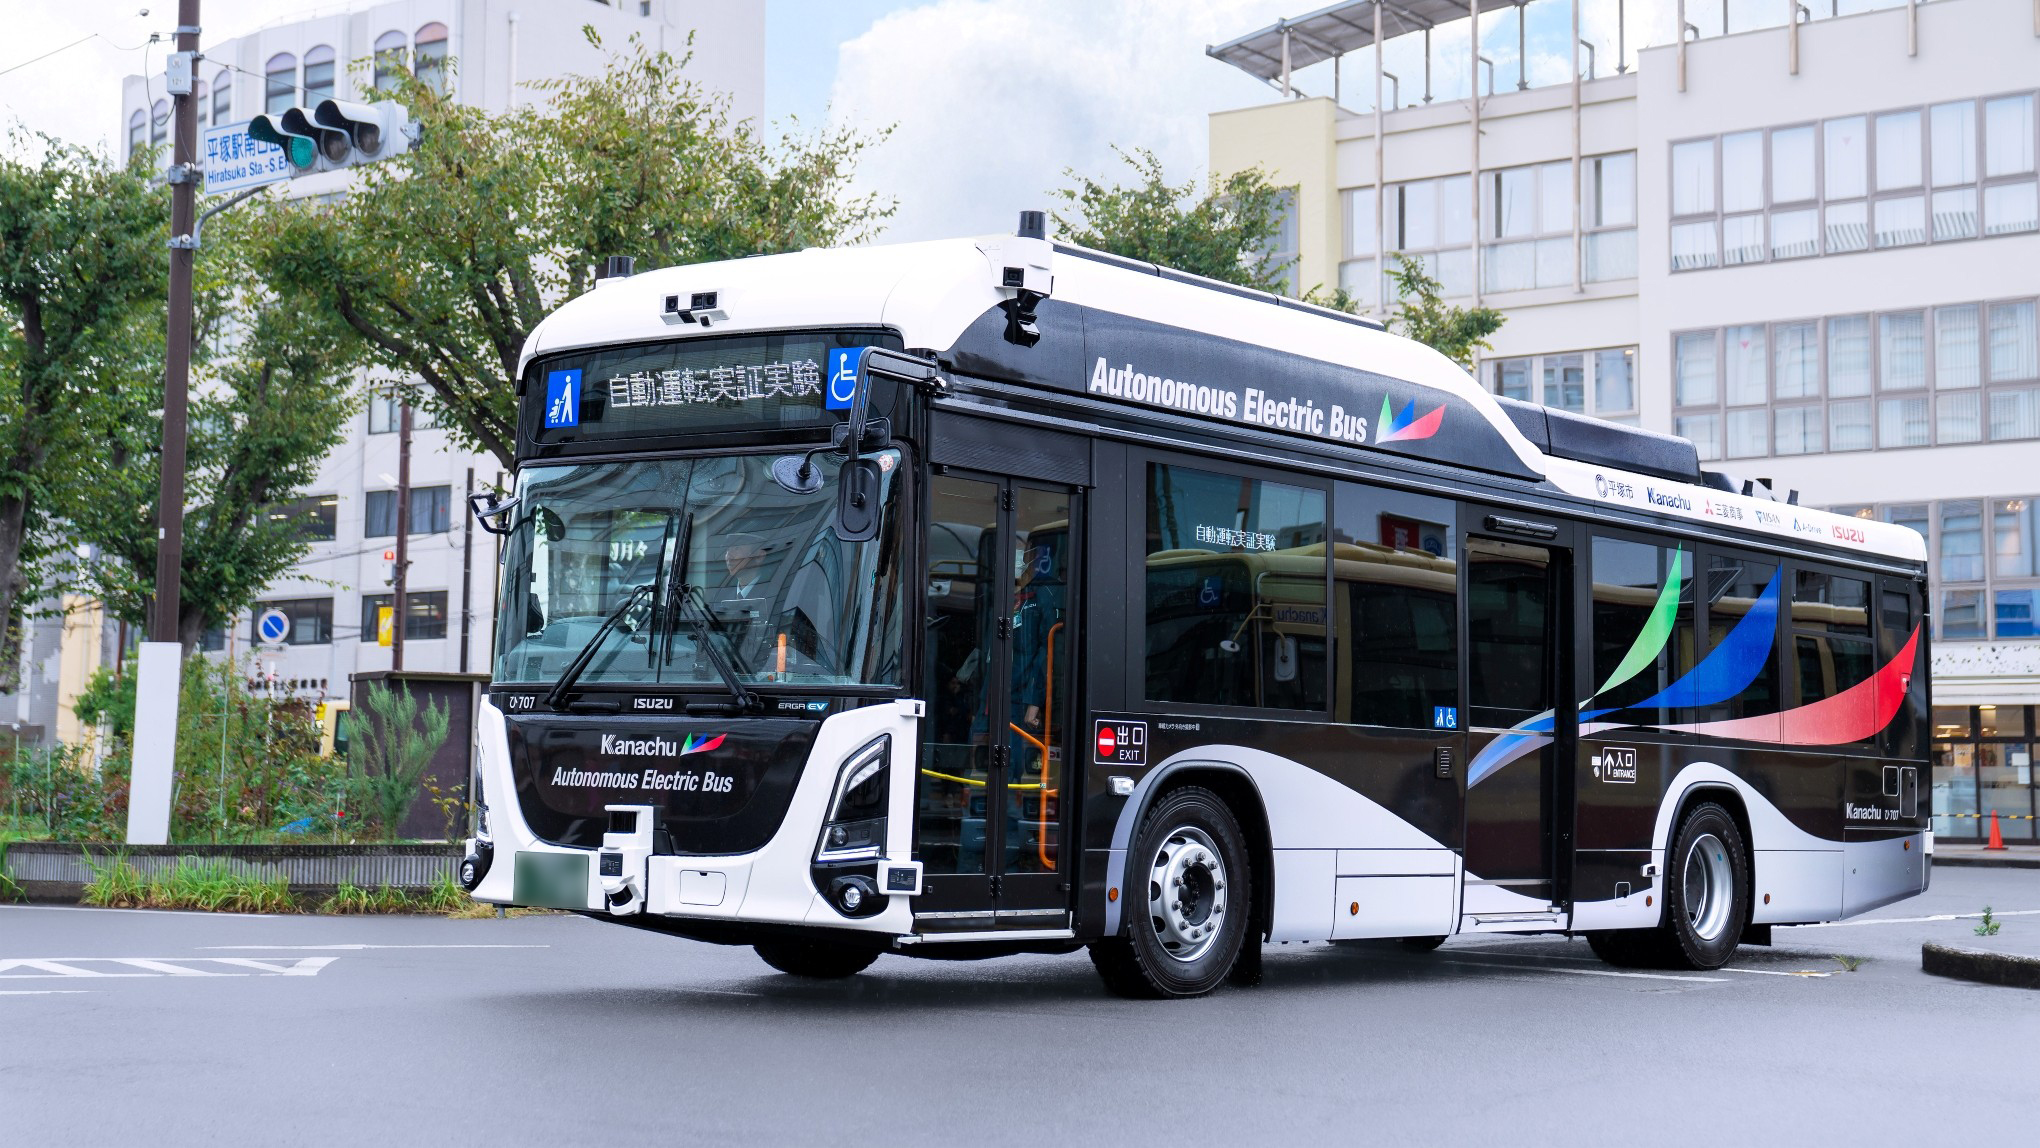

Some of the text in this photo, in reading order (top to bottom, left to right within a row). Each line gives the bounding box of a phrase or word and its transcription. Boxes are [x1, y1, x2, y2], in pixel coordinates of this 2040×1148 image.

[208, 165, 246, 184] Hiratsuka
[609, 358, 821, 407] 自動運転実証実験
[1090, 357, 1367, 443] Autonomous Electric Bus
[1608, 480, 1634, 499] 平塚市
[1647, 487, 1691, 511] Kanachu
[1196, 524, 1276, 552] 自動運転実証実験
[1832, 525, 1864, 543] ISUZU
[633, 698, 673, 709] ISUZU
[778, 702, 805, 710] ERGA
[601, 734, 676, 757] Kanachu
[1117, 726, 1144, 746] 出口
[1119, 750, 1140, 761] EXIT
[1615, 751, 1633, 767] 入口
[551, 766, 733, 793] Autonomous Electric Bus
[1613, 769, 1636, 778] ENTRANCE
[1846, 802, 1882, 820] Kanachu
